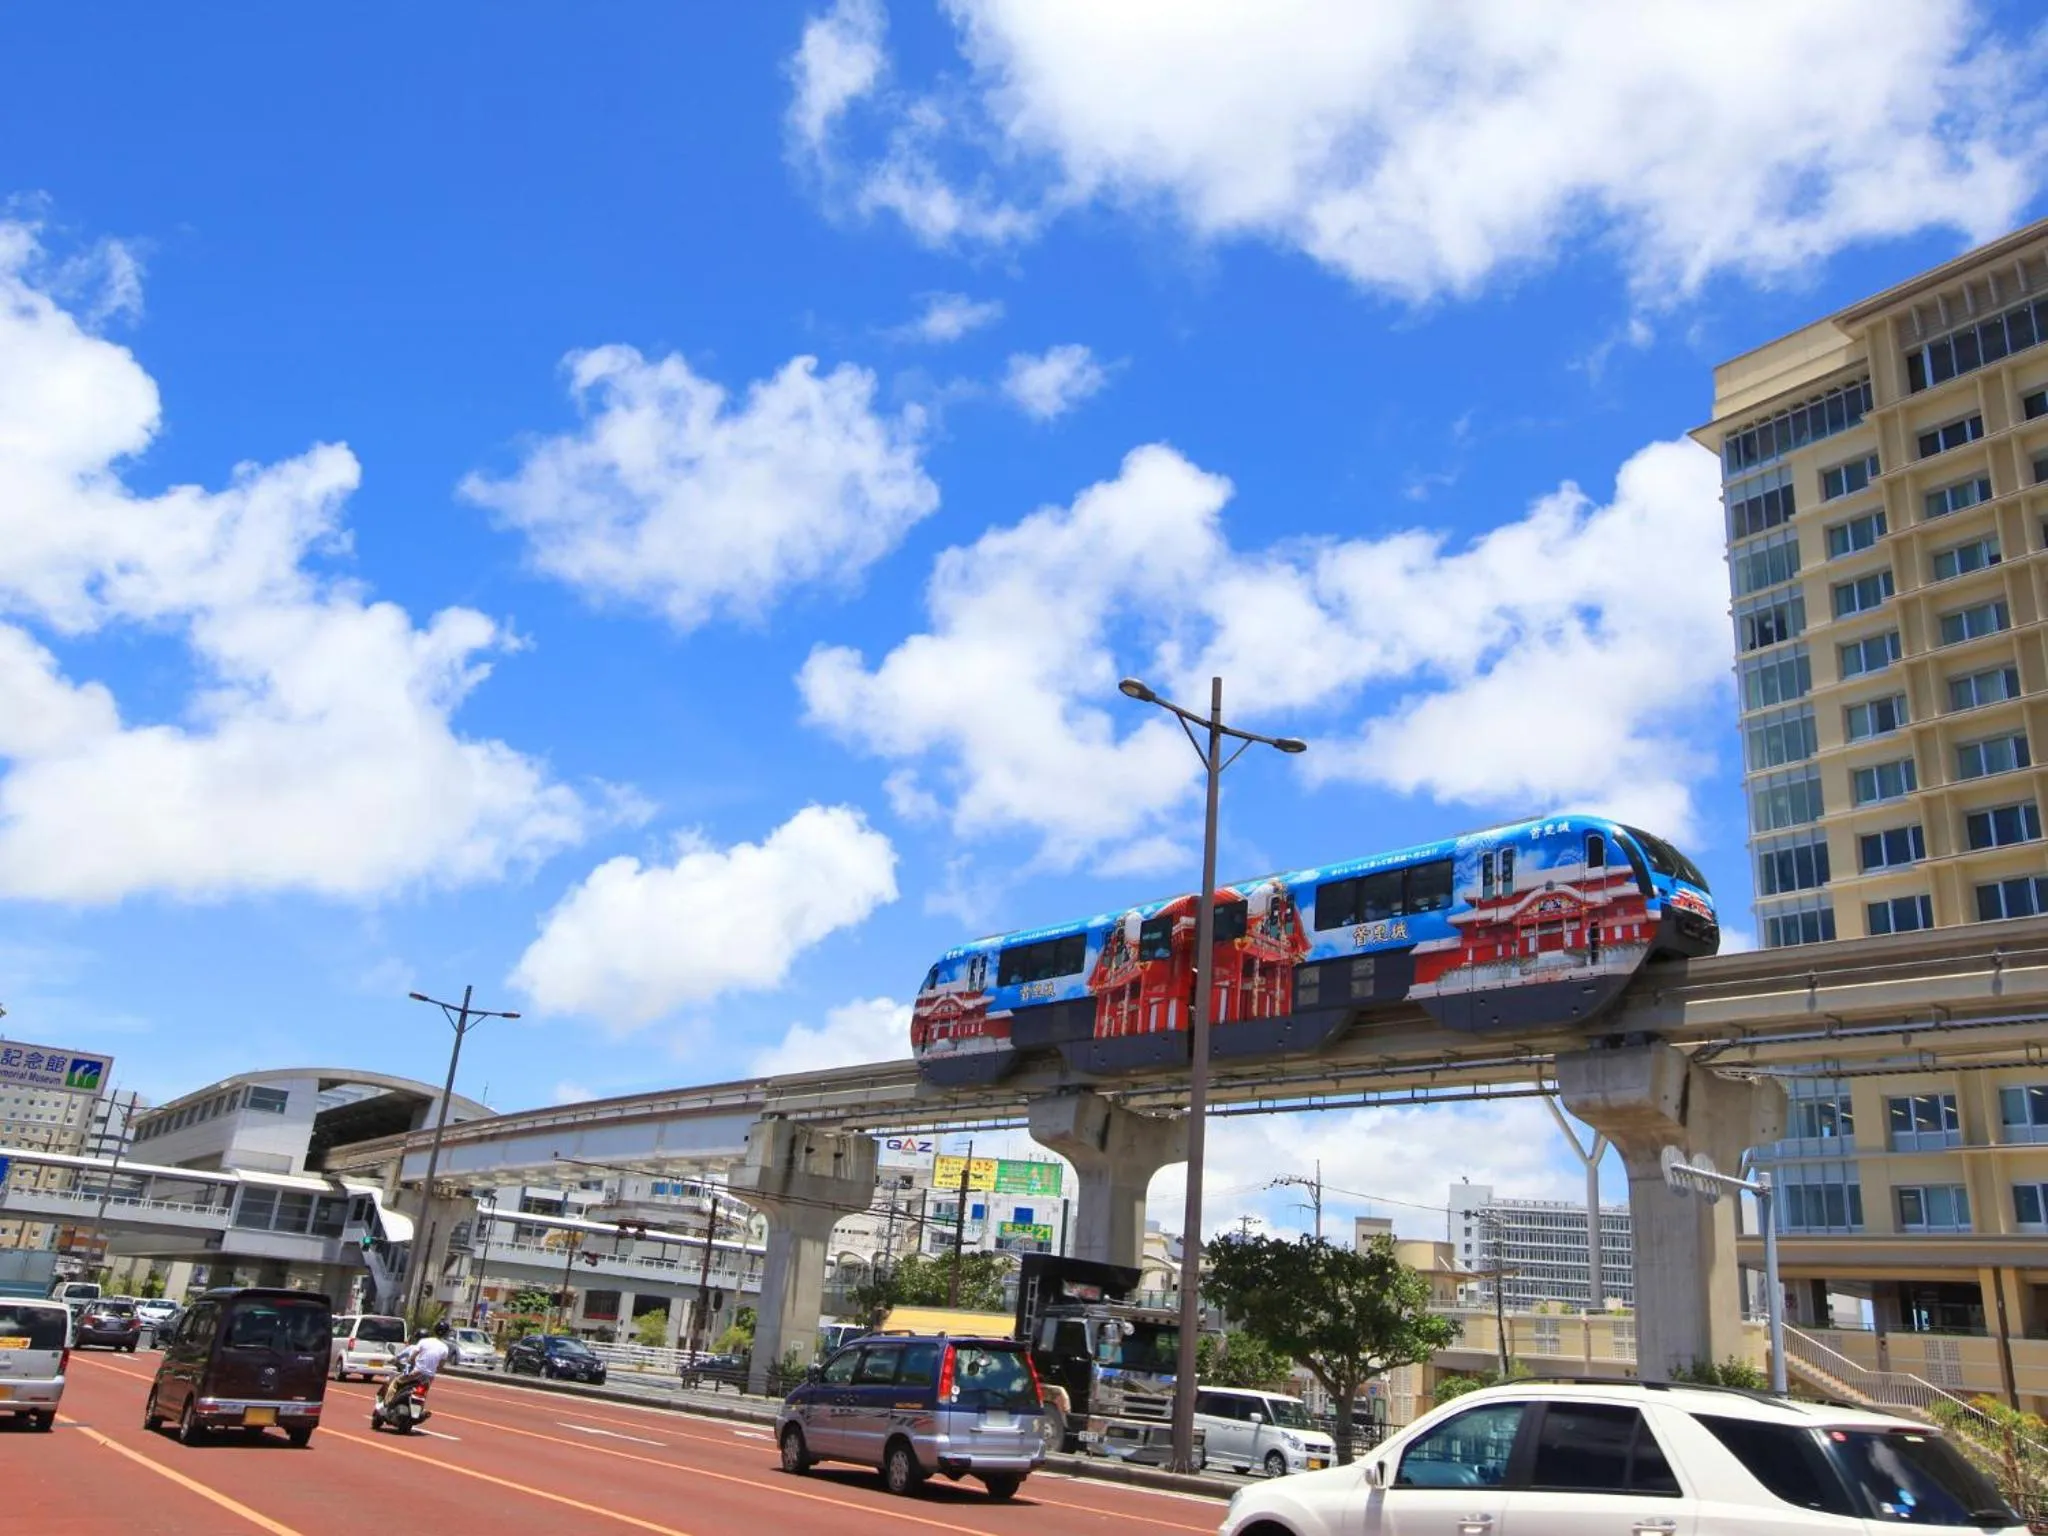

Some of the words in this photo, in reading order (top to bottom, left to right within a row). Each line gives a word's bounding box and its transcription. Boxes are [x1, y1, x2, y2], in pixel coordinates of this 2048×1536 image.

[0, 1048, 67, 1073] 記念館
[29, 1071, 61, 1085] Museum
[886, 1137, 933, 1153] GAZ
